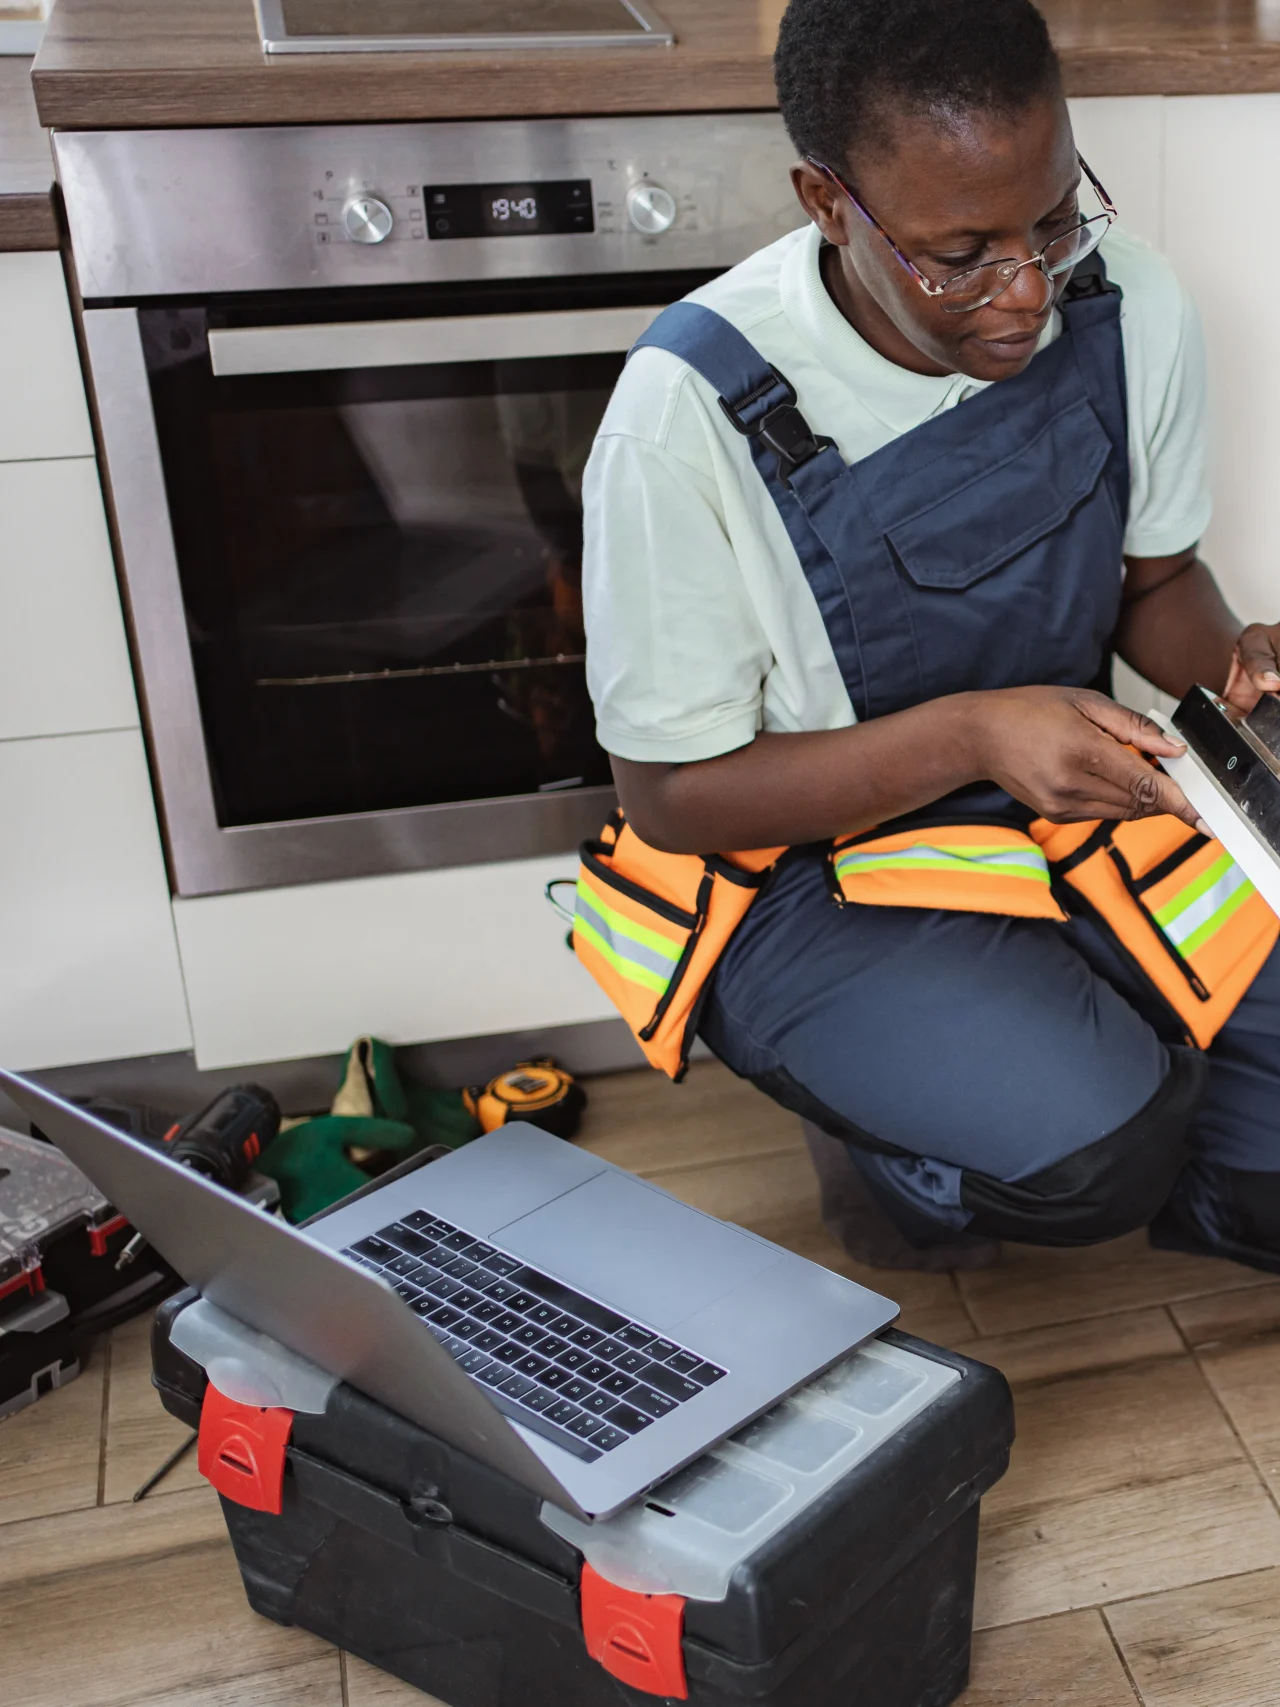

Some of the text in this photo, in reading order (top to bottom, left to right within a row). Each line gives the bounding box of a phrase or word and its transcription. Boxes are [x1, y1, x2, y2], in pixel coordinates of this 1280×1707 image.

[492, 197, 537, 220] 1940
[496, 1254, 518, 1267] command
[494, 1287, 506, 1295] M
[460, 1295, 470, 1303] K
[516, 1298, 527, 1306] N
[538, 1310, 548, 1318] B
[461, 1324, 472, 1332] U
[629, 1324, 652, 1339] command
[604, 1345, 614, 1353] X
[657, 1340, 674, 1350] option
[568, 1355, 578, 1363] D
[626, 1357, 637, 1365] Z
[679, 1352, 698, 1363] control
[526, 1361, 536, 1369] R
[549, 1373, 559, 1381] E
[570, 1385, 581, 1394] W
[683, 1381, 696, 1390] shift
[650, 1392, 662, 1401] lock
[594, 1397, 604, 1406] Q
[659, 1397, 672, 1406] caps
